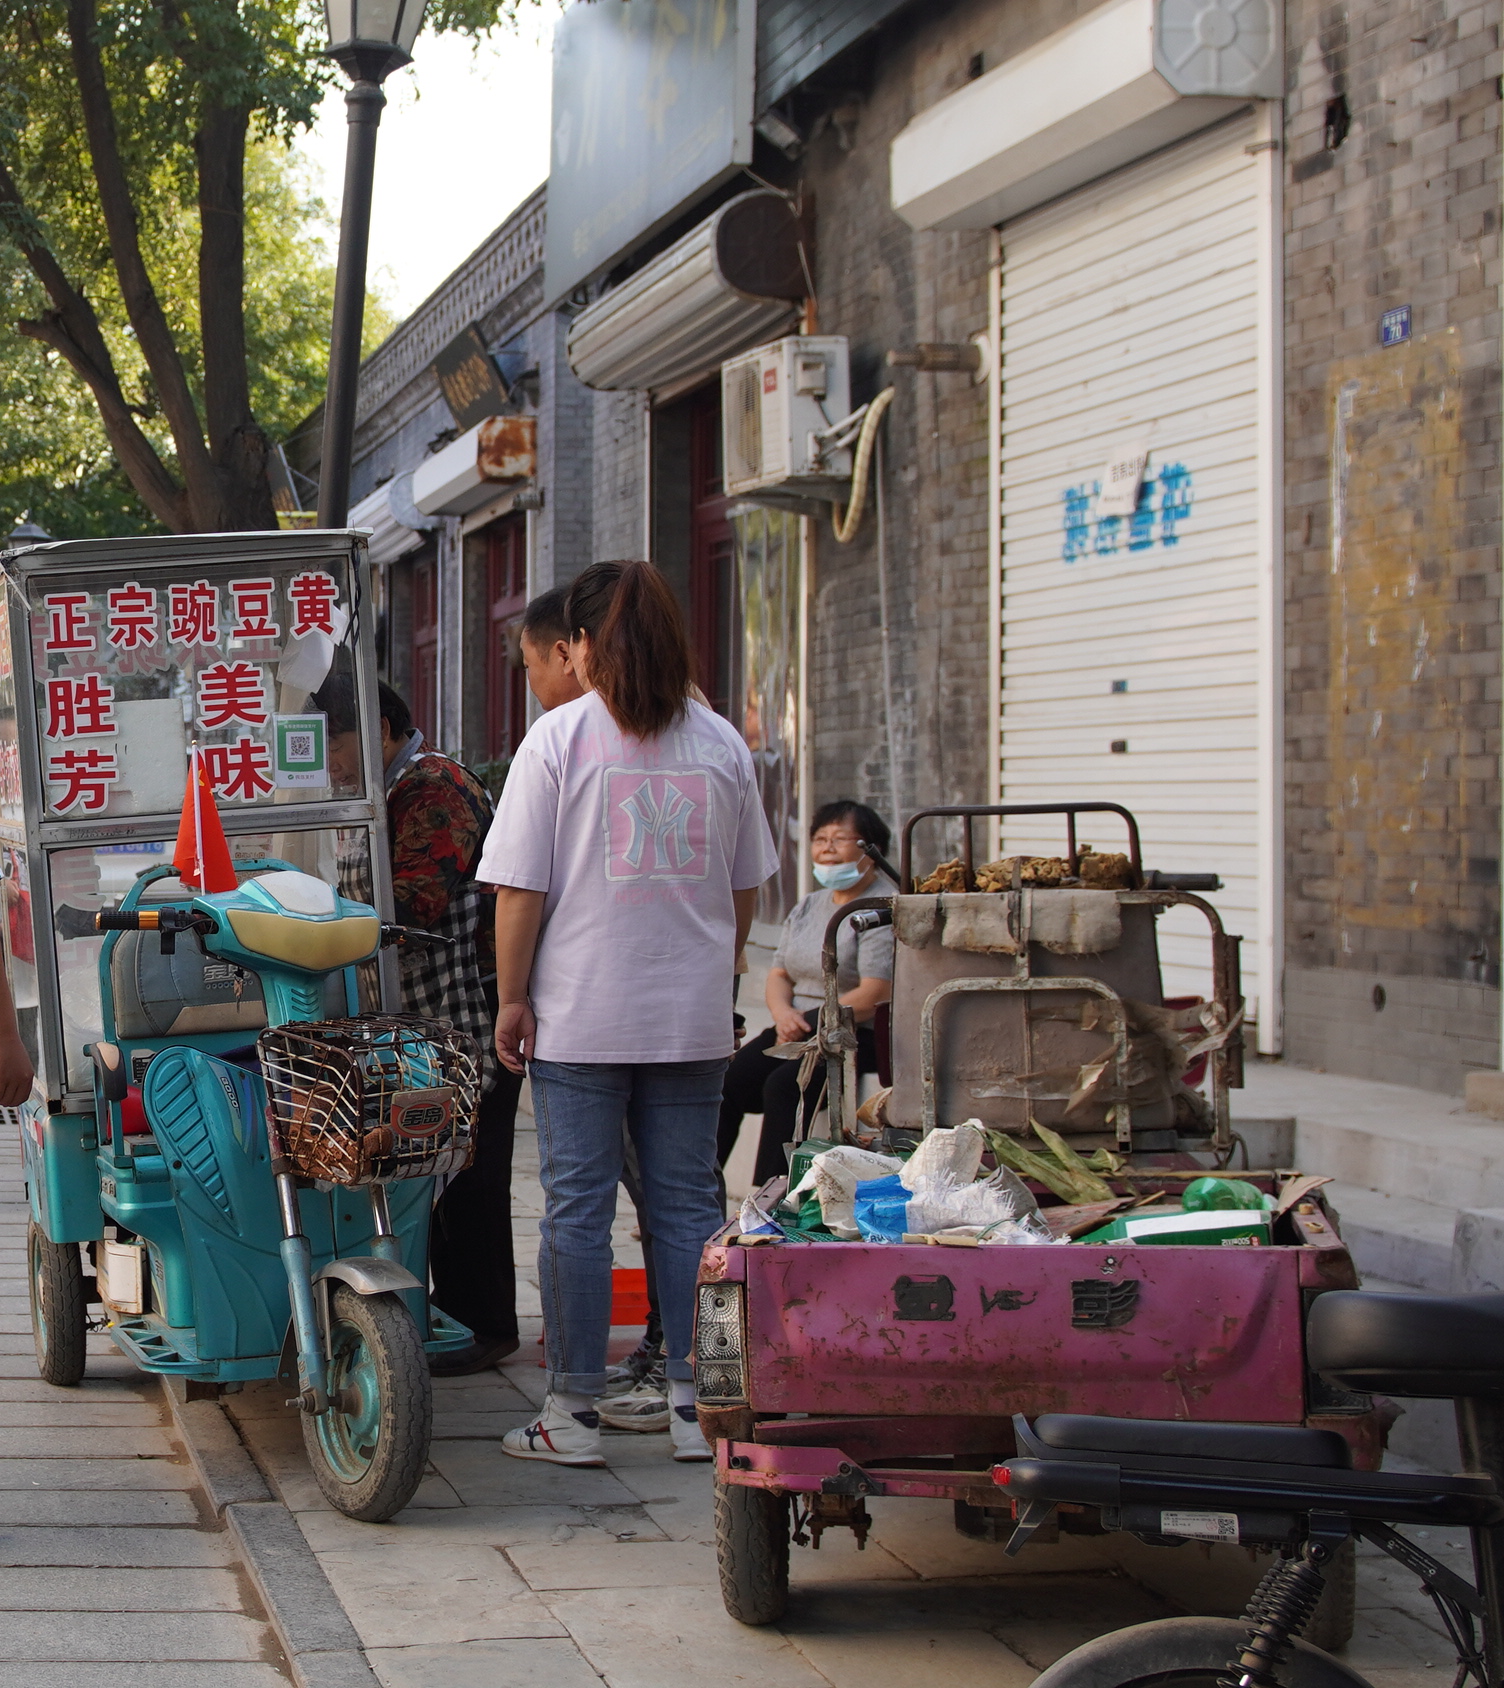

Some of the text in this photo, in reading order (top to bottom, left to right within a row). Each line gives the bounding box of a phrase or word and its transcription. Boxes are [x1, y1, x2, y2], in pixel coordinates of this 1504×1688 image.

[43, 571, 339, 653] 正宗豌豆黄
[673, 731, 729, 767] like
[618, 778, 698, 870] NY
[615, 886, 699, 905] NEW YORK
[402, 1105, 443, 1127] 宝岛
